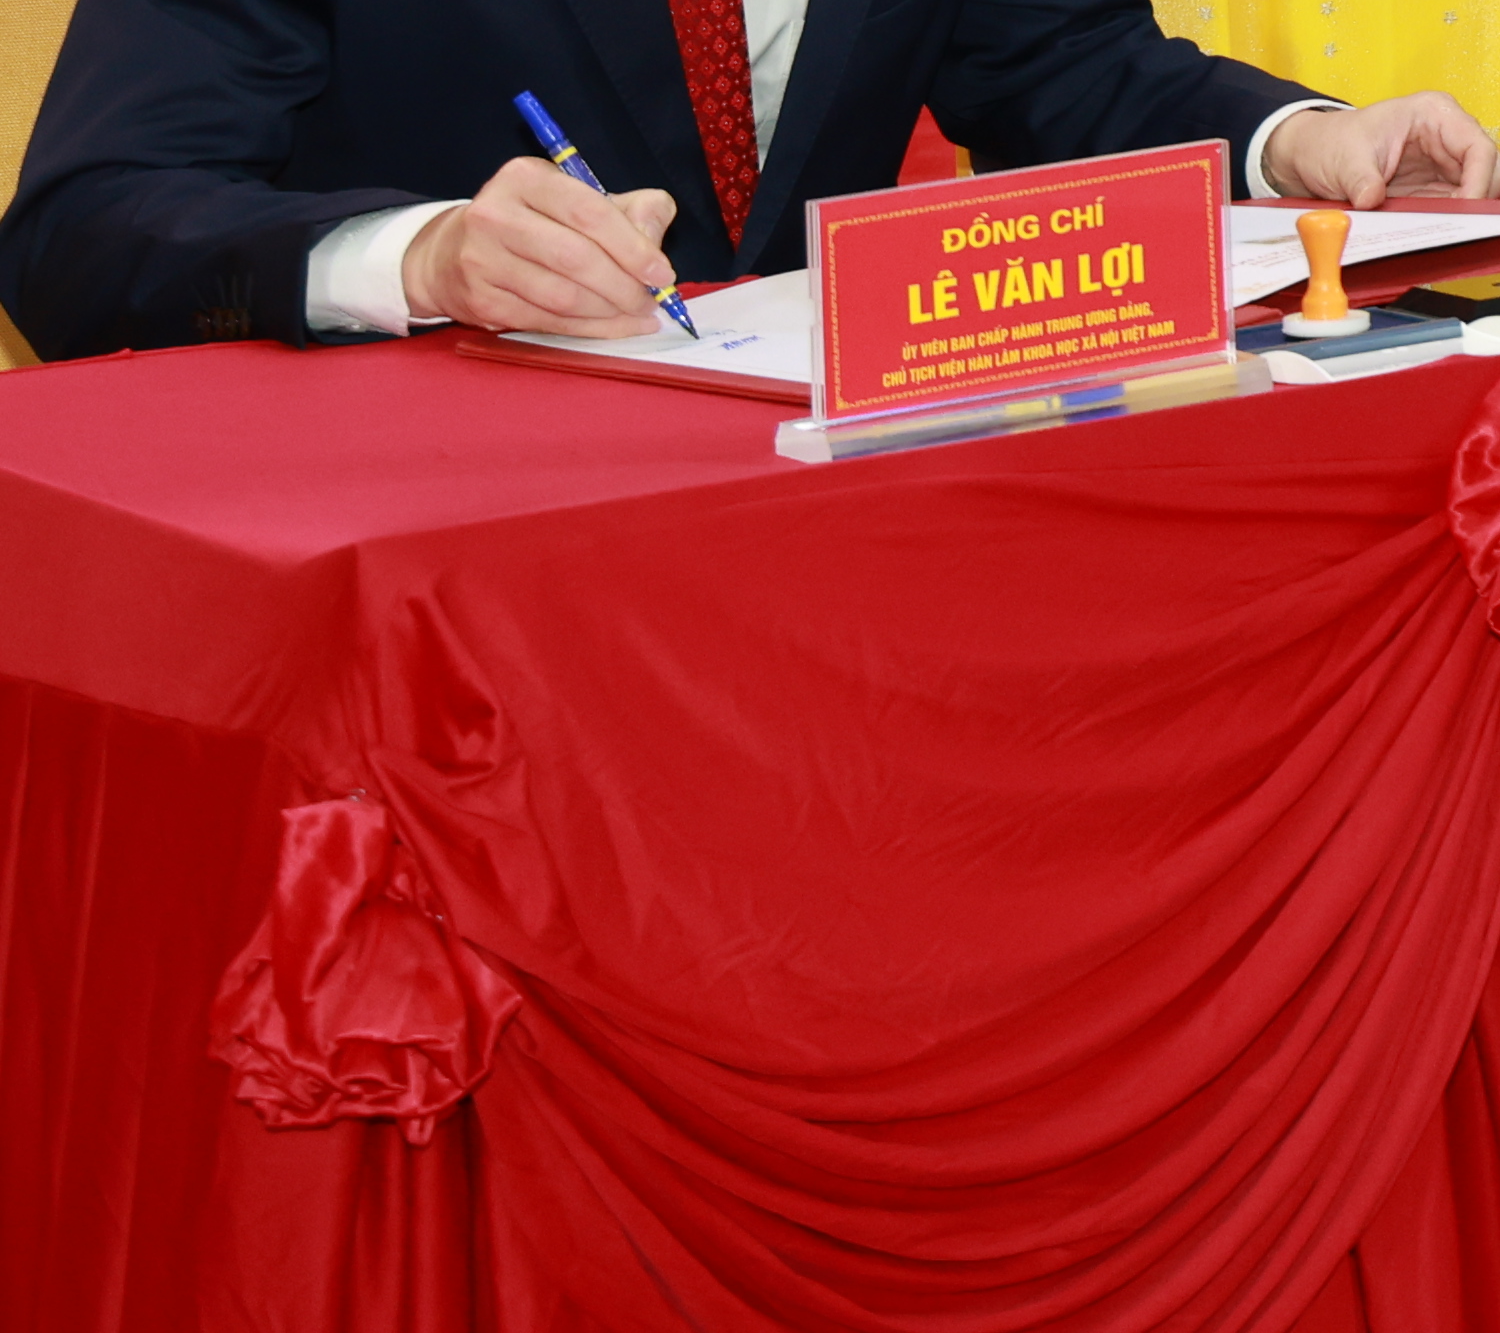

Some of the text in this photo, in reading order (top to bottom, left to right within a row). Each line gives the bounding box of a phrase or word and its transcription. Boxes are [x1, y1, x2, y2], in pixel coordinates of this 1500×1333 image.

[942, 196, 1105, 254] ĐỒNG CHÍ
[907, 241, 1147, 325] LÊ VĂN LỢI
[882, 365, 907, 388] CHỦ
[909, 364, 936, 385] TỊCH
[938, 358, 966, 378] VIỆN
[967, 353, 993, 372] HÀN
[995, 348, 1020, 367] LÂM
[1022, 343, 1054, 362] KHOA
[1055, 338, 1080, 357] HỌC
[1099, 328, 1120, 349] HỘI
[1121, 324, 1146, 344] VIỆT
[1147, 320, 1175, 338] NAM
[902, 341, 918, 361] ỦY
[920, 338, 948, 357] VIÊN
[950, 334, 976, 352] BAN
[978, 324, 1009, 347] CHẤP
[1011, 321, 1044, 341] HÀNH
[1045, 314, 1083, 334] TRUNG
